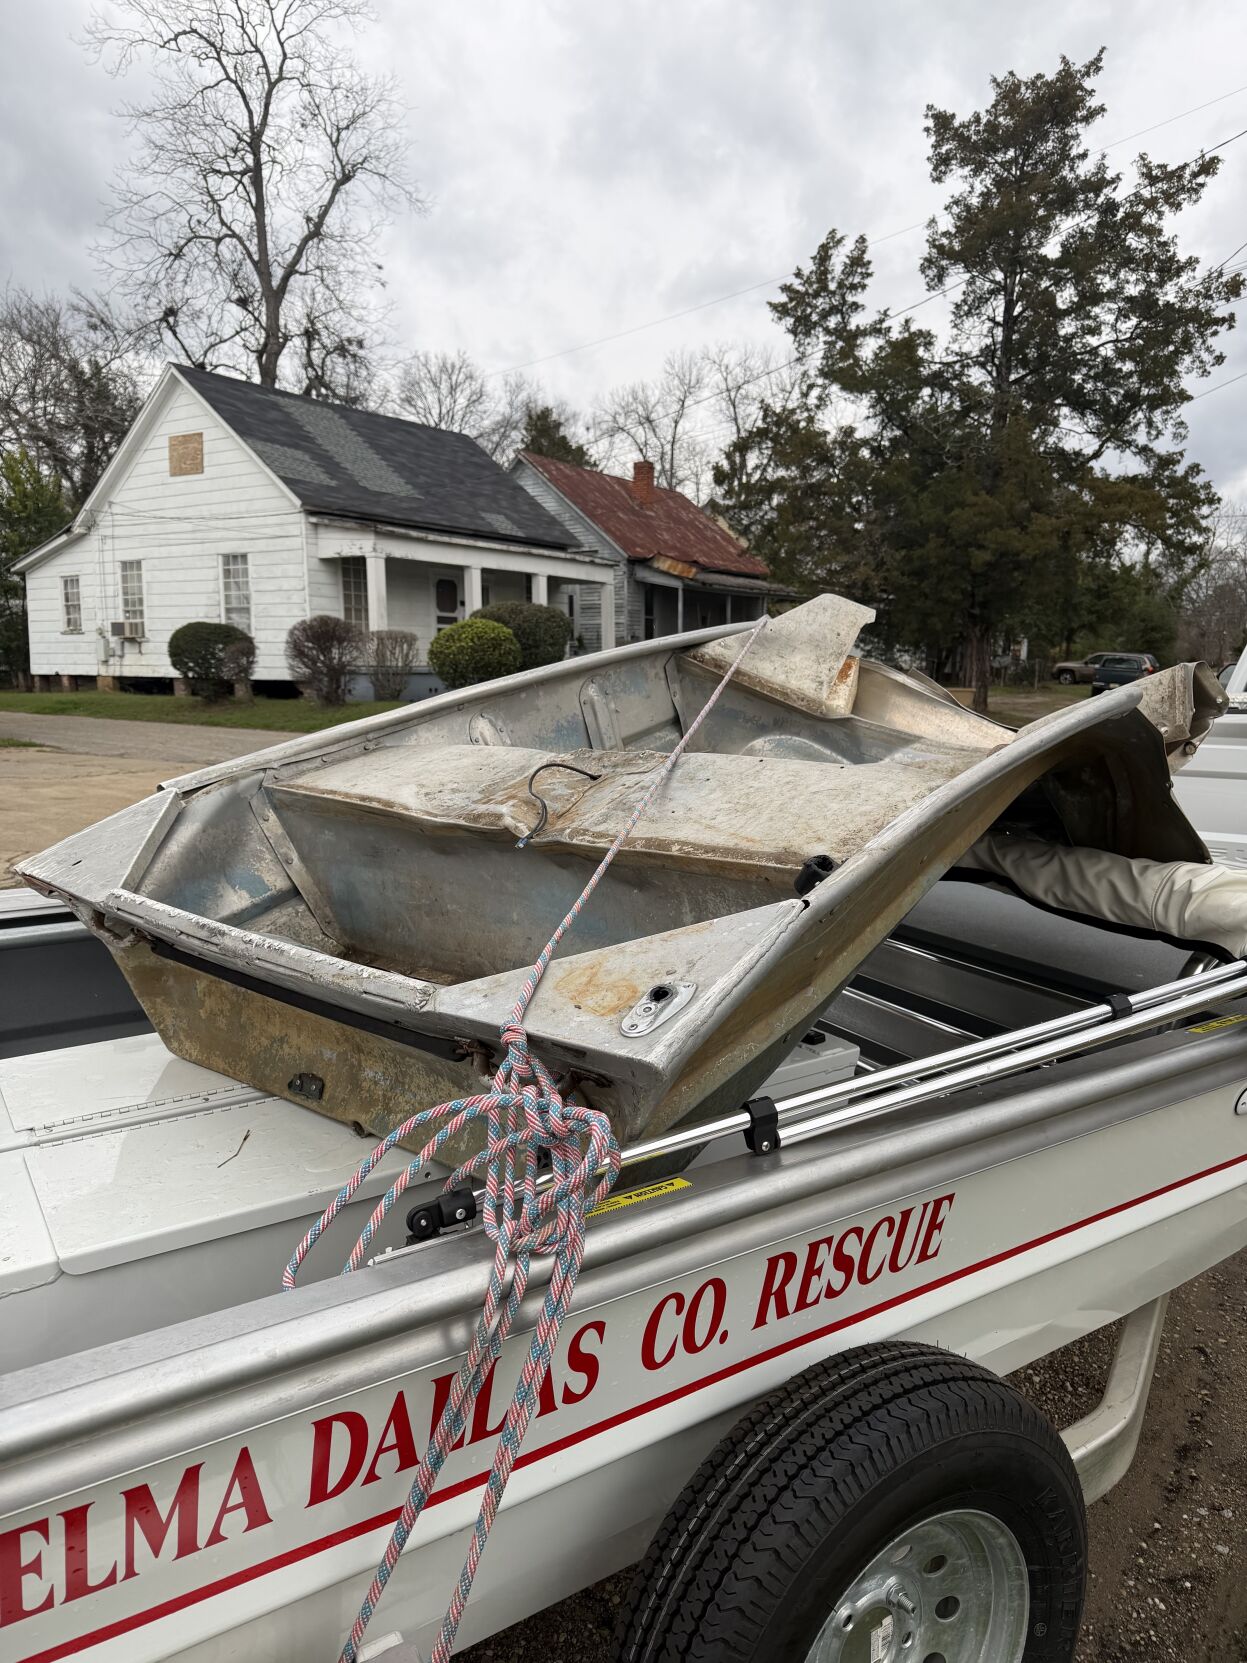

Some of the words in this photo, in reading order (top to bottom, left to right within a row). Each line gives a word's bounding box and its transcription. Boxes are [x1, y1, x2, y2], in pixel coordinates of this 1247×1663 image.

[0, 1447, 273, 1628] ELMA
[641, 1277, 729, 1371] CO.
[752, 1193, 956, 1330] RESCUE
